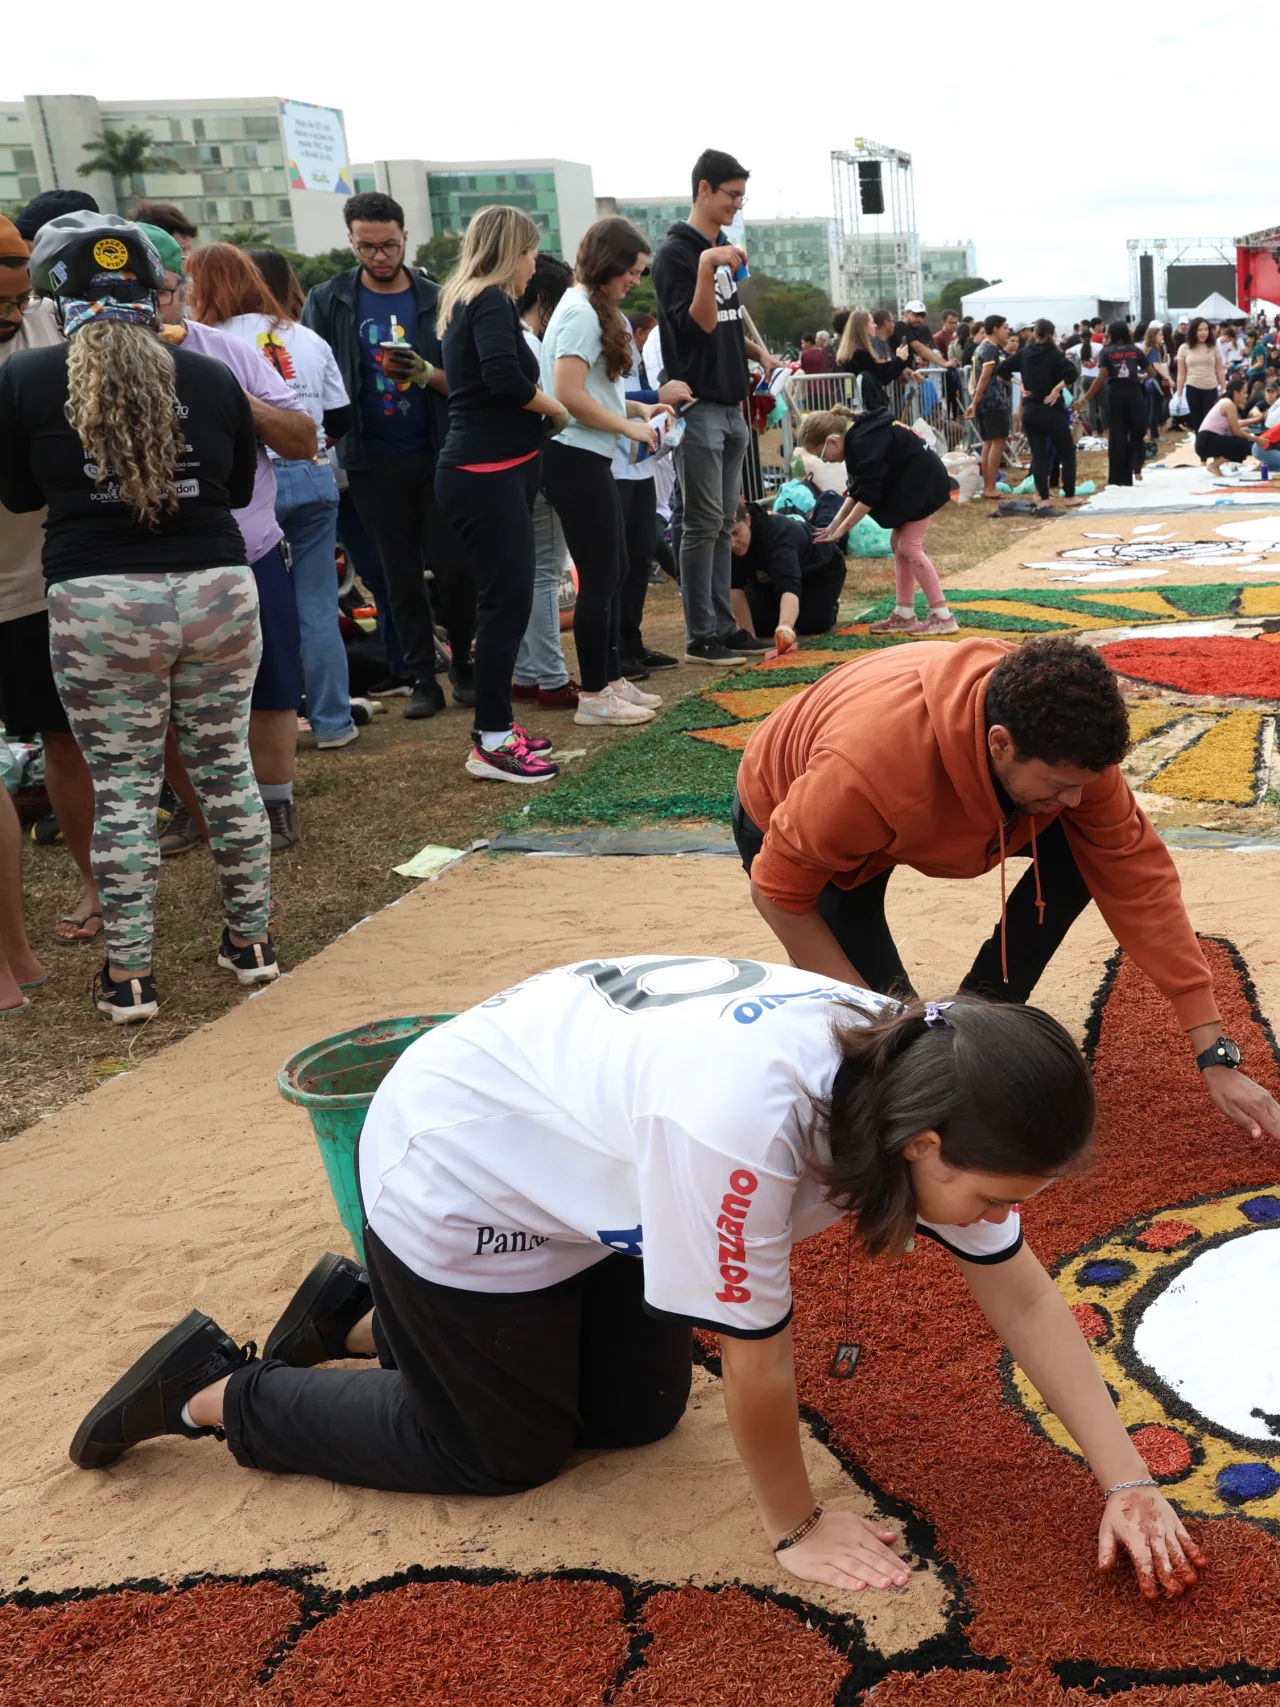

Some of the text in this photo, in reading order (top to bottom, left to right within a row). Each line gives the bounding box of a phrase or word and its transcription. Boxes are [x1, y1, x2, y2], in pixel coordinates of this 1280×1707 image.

[96, 240, 126, 257] CAPACETE
[106, 258, 125, 268] VIDA
[716, 1168, 758, 1303] bozzano
